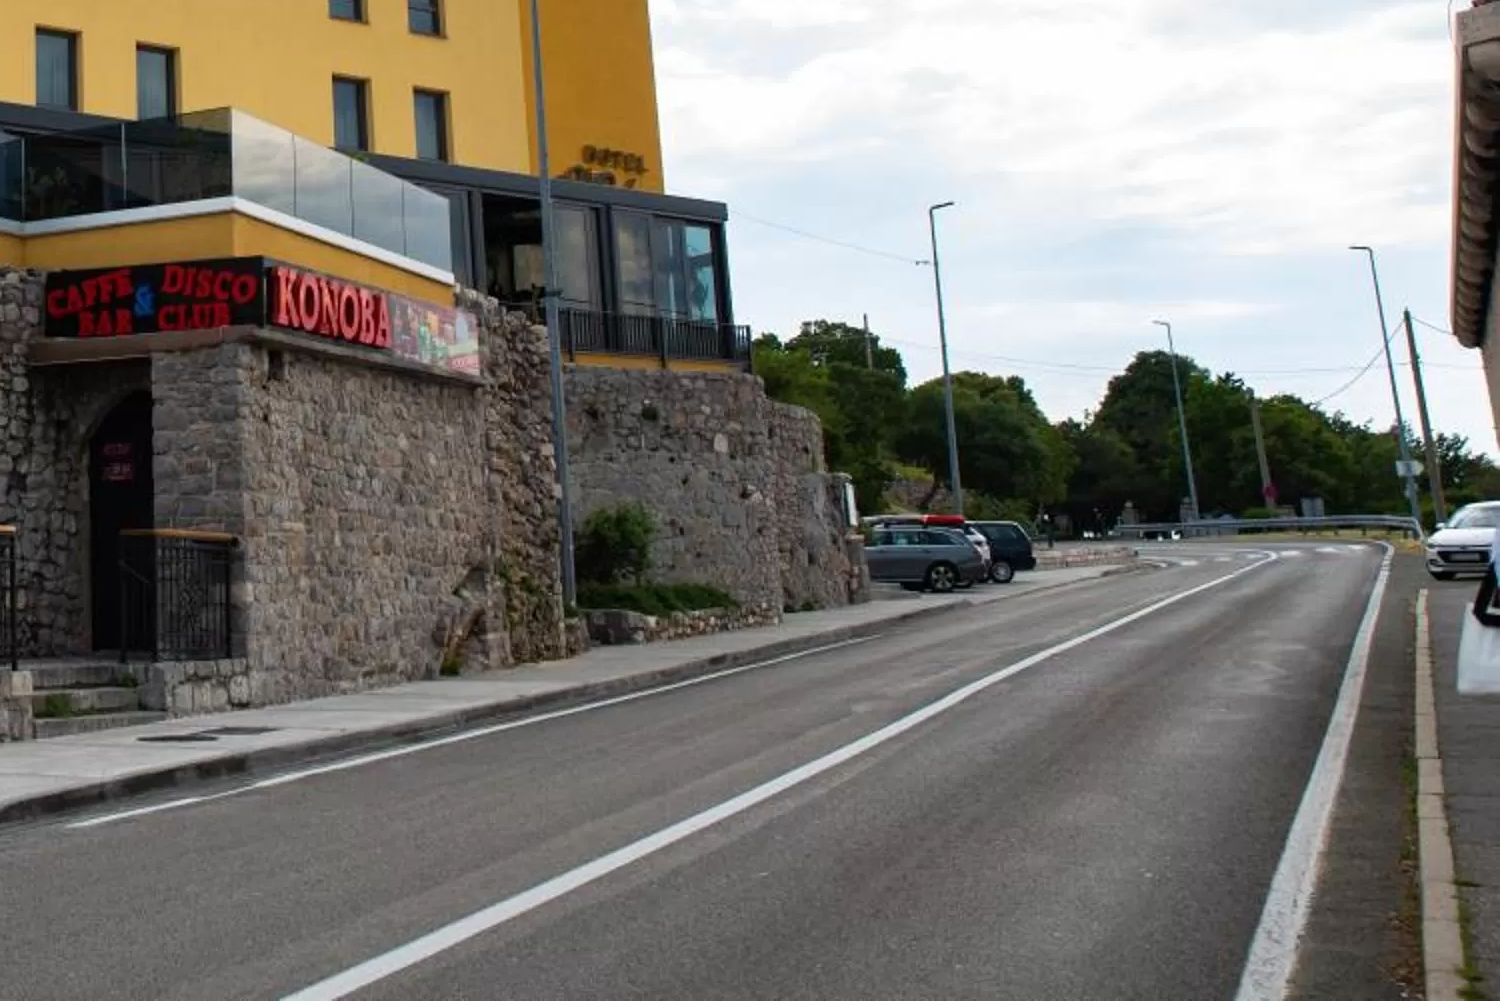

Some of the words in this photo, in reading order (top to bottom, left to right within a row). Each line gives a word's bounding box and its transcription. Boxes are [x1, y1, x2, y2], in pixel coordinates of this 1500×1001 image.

[48, 268, 133, 319] CAFFE
[133, 283, 155, 317] &
[162, 264, 259, 306] DISCO
[78, 308, 133, 337] BAR
[157, 301, 231, 332] CLUB
[274, 265, 394, 349] KONOBA
